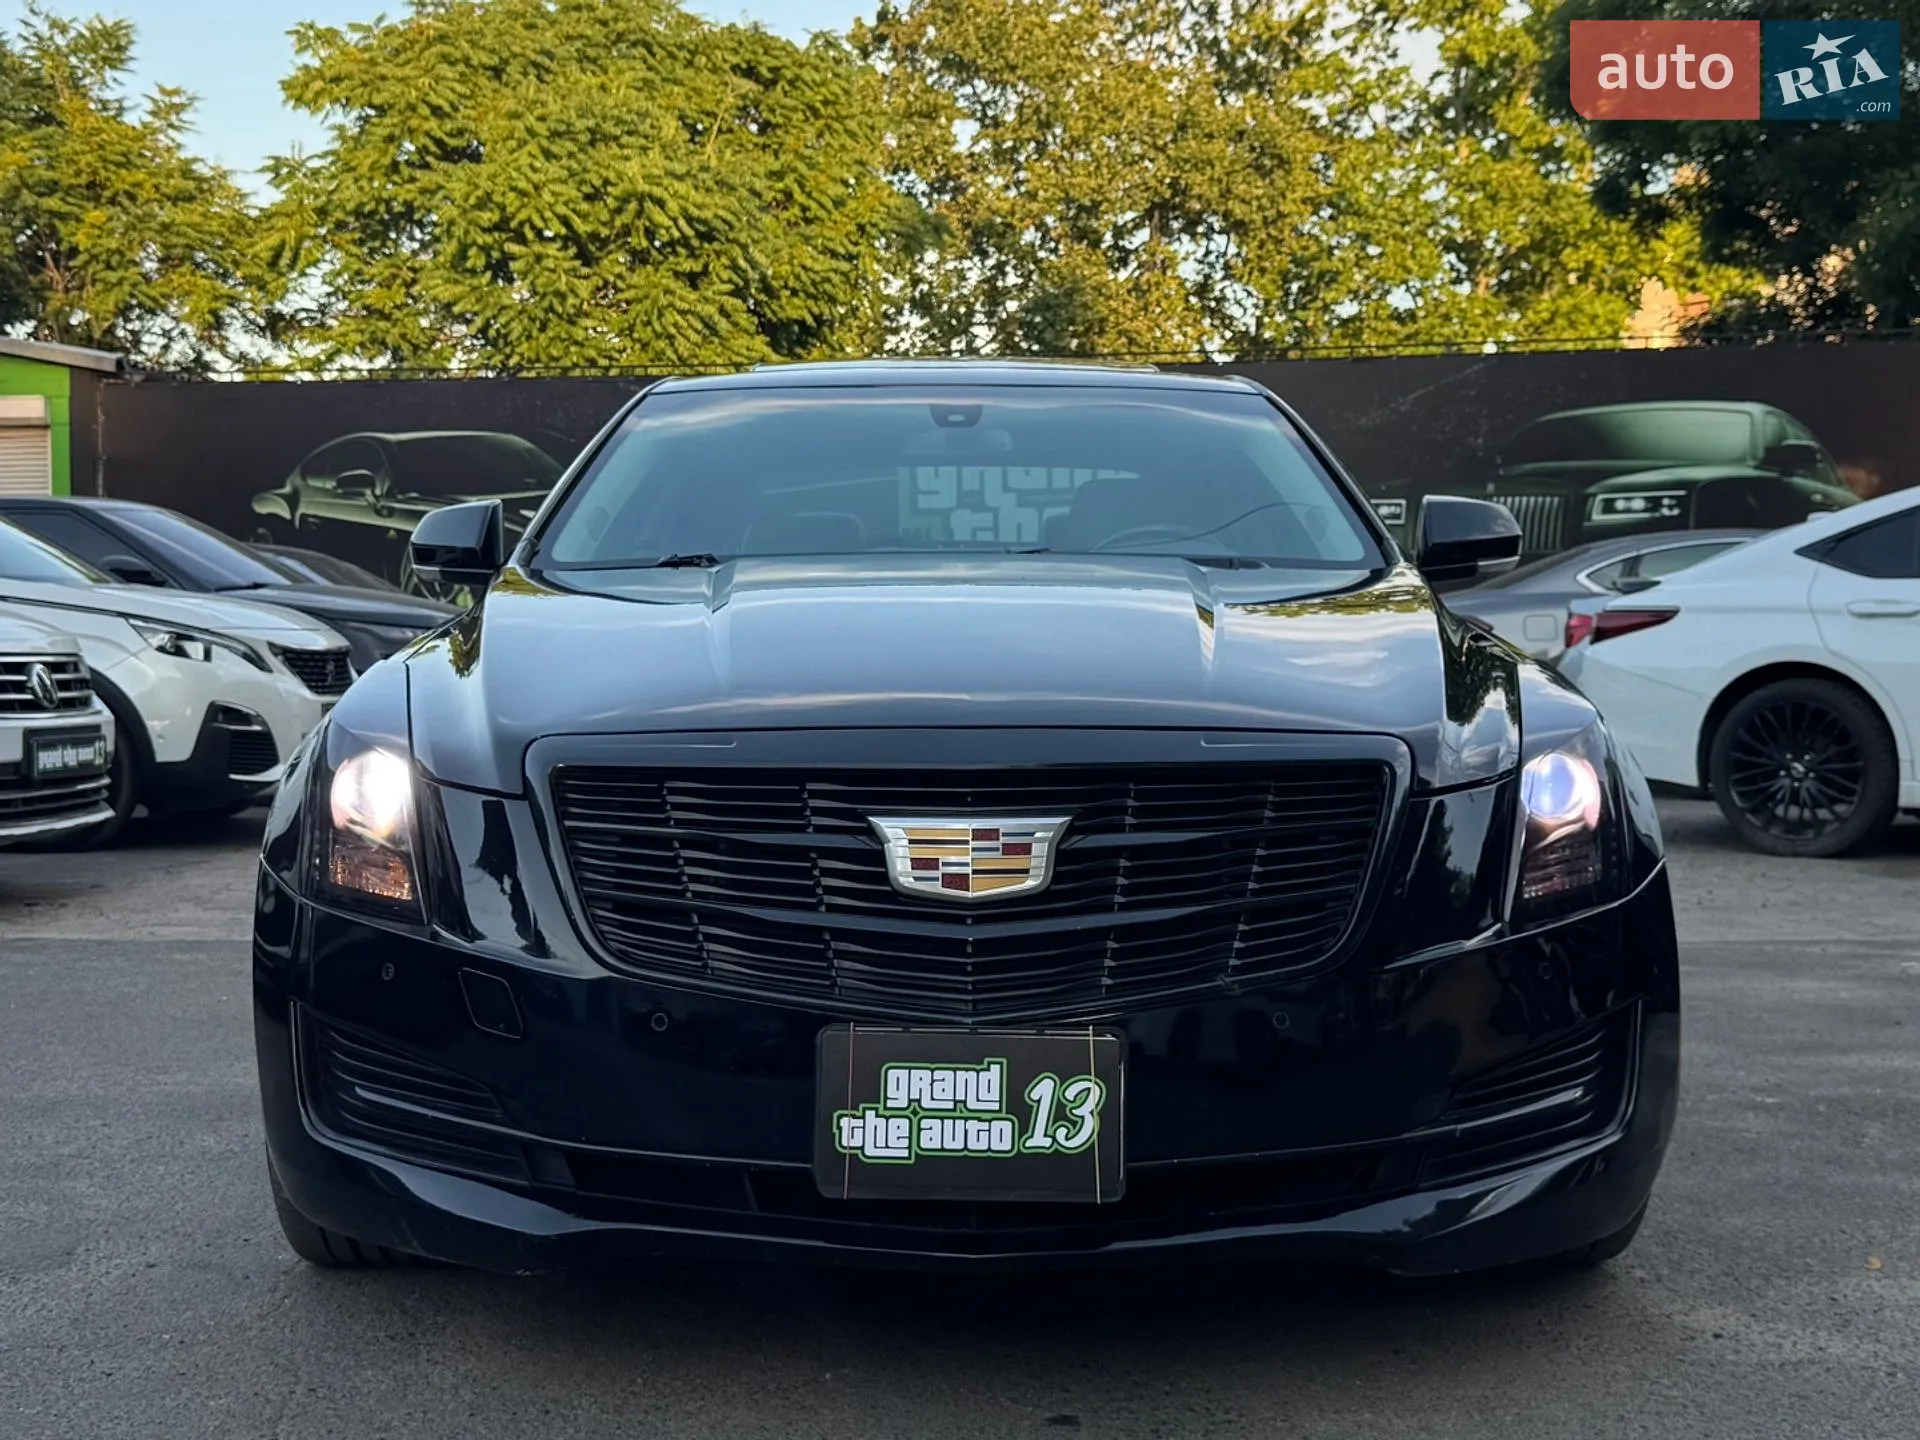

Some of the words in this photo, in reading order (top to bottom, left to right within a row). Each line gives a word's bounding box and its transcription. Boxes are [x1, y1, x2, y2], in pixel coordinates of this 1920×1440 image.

[886, 1064, 1000, 1111] grand
[840, 1110, 909, 1157] the
[920, 1118, 1013, 1151] auto
[1025, 1078, 1101, 1149] 13
